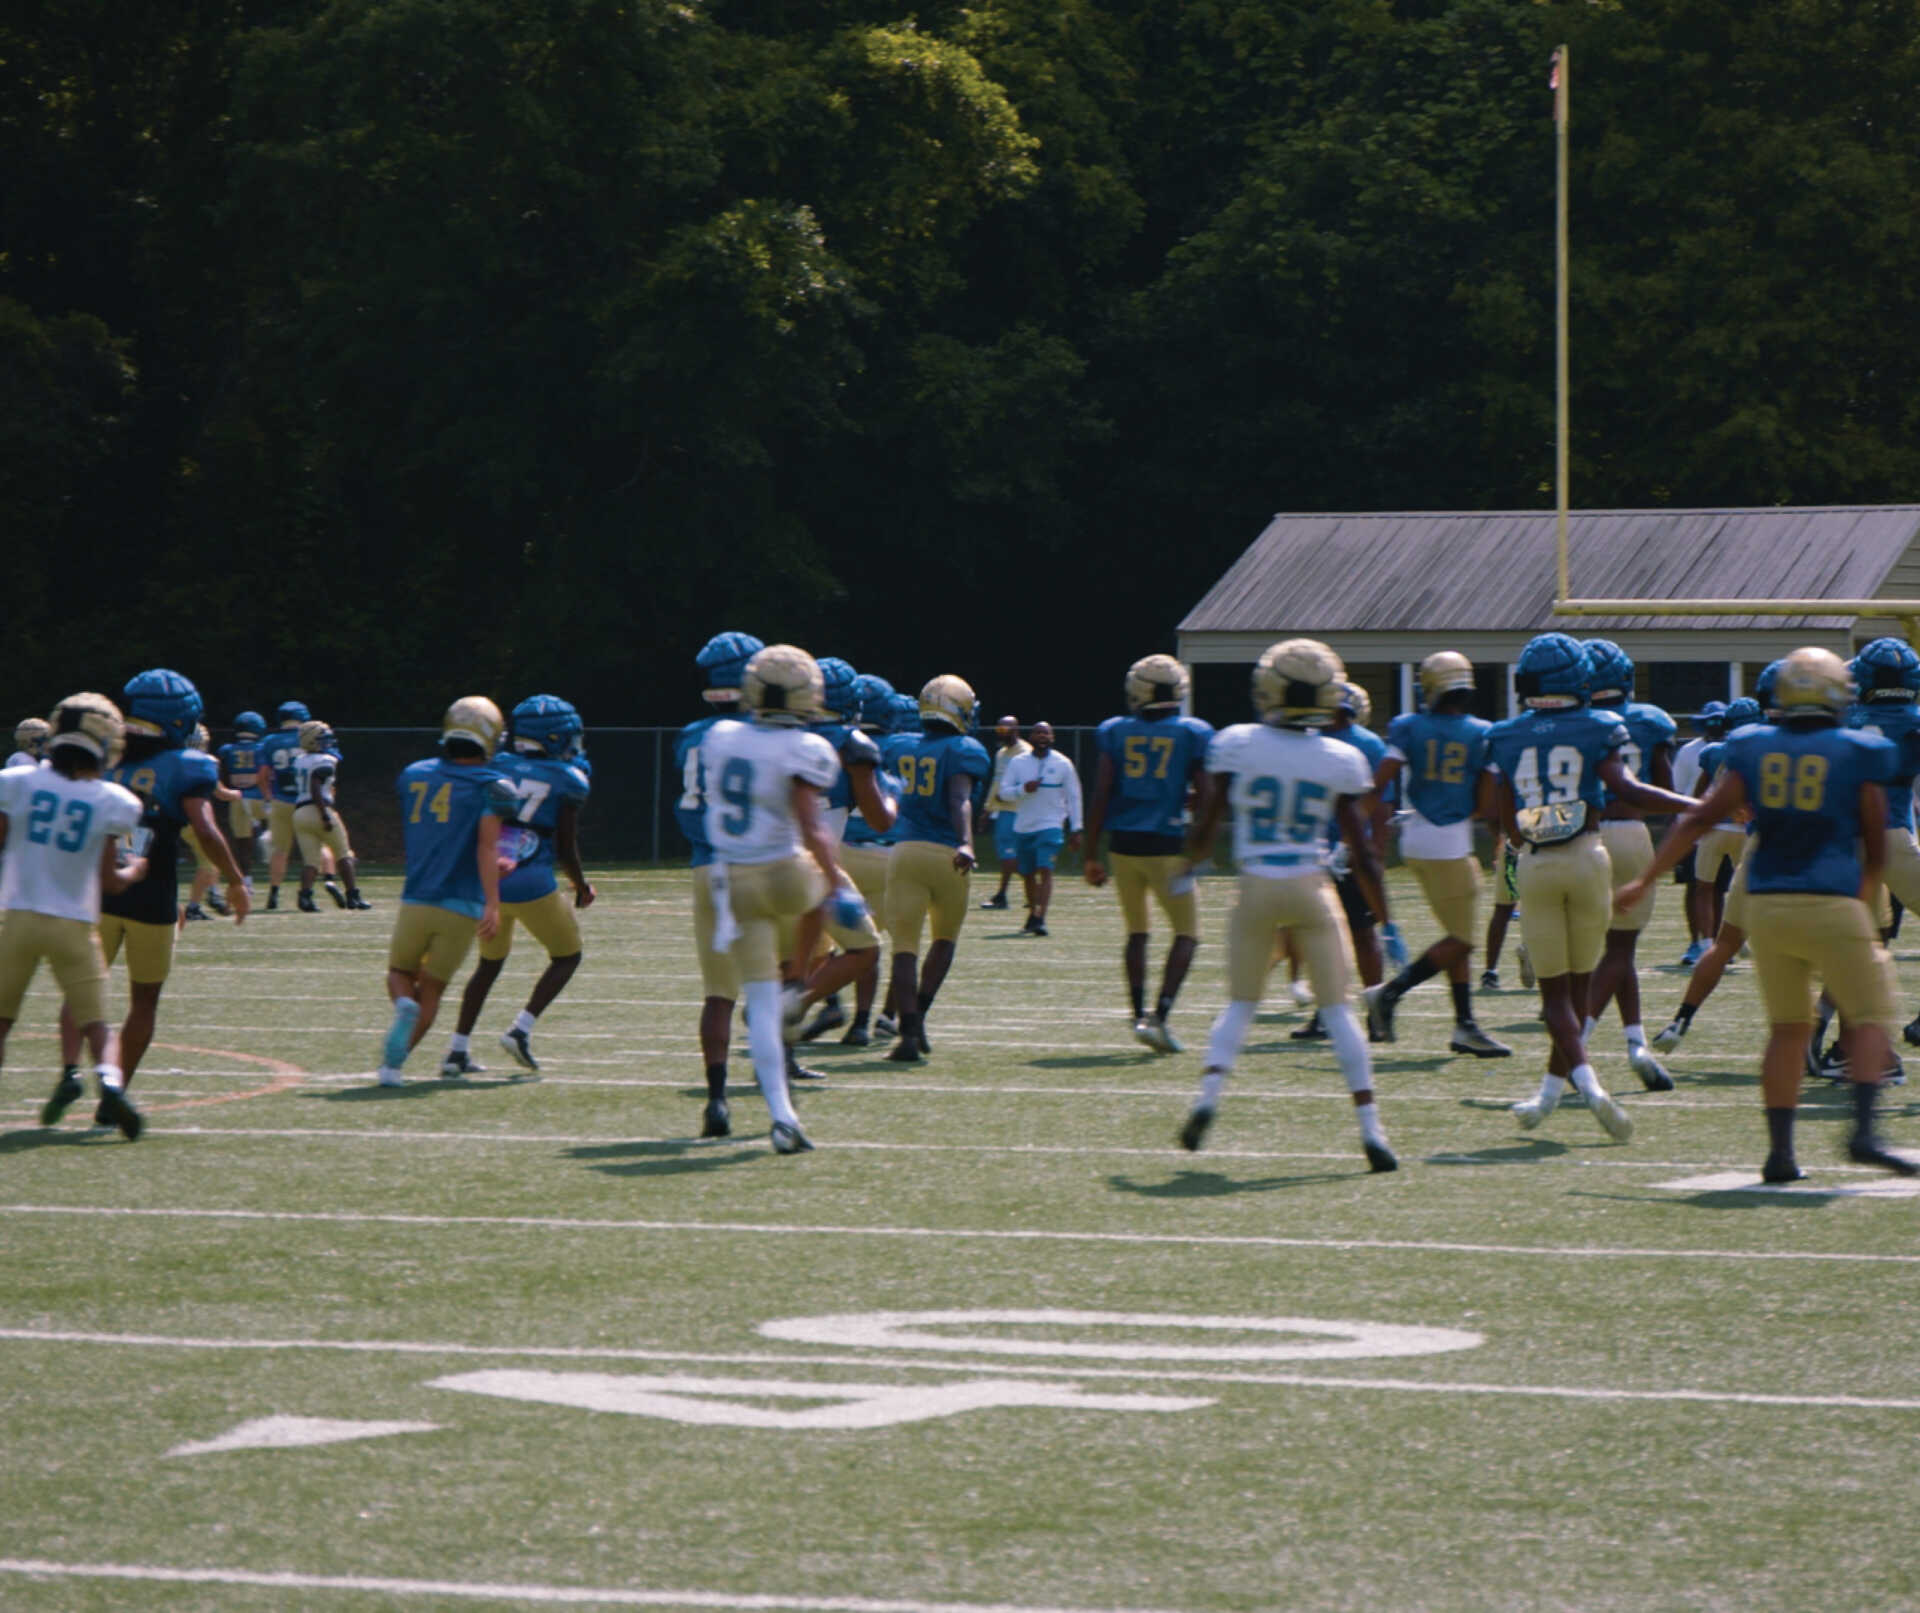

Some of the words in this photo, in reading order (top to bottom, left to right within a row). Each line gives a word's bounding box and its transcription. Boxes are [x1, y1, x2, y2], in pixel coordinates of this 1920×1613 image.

[1123, 736, 1175, 780] 57
[1424, 738, 1468, 784] 12
[1513, 744, 1585, 808] 49
[1758, 752, 1830, 812] 88
[27, 788, 94, 853] 23
[408, 781, 453, 824] 74
[722, 756, 756, 837] 9
[1250, 776, 1329, 844] 25
